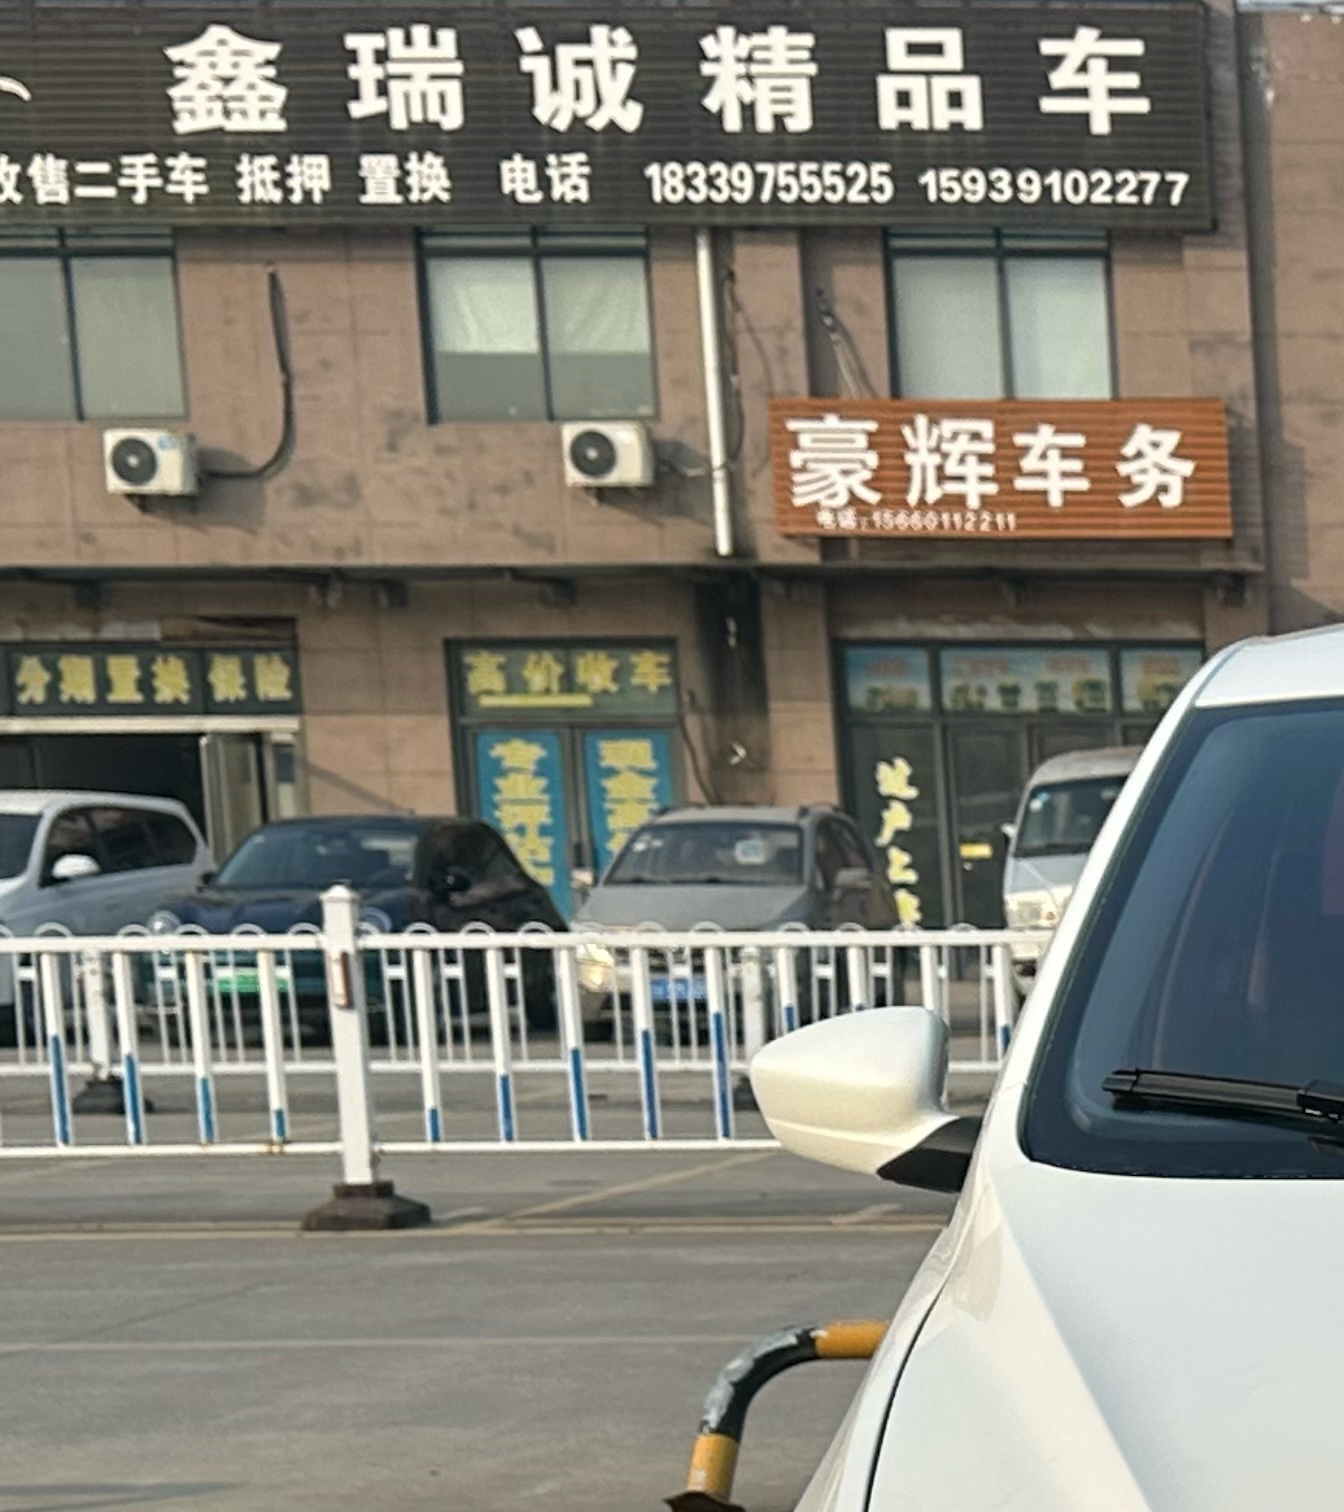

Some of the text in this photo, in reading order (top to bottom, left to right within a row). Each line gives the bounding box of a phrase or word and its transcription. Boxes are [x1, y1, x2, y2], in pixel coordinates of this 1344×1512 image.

[164, 24, 1151, 135] 鑫瑞诚精品车
[236, 153, 332, 204] 抵押
[359, 152, 452, 204] 置换
[500, 152, 592, 204] 电话
[644, 161, 895, 204] 18339755525
[918, 168, 1190, 206] 15939102277
[786, 413, 1195, 509] 豪辉车务
